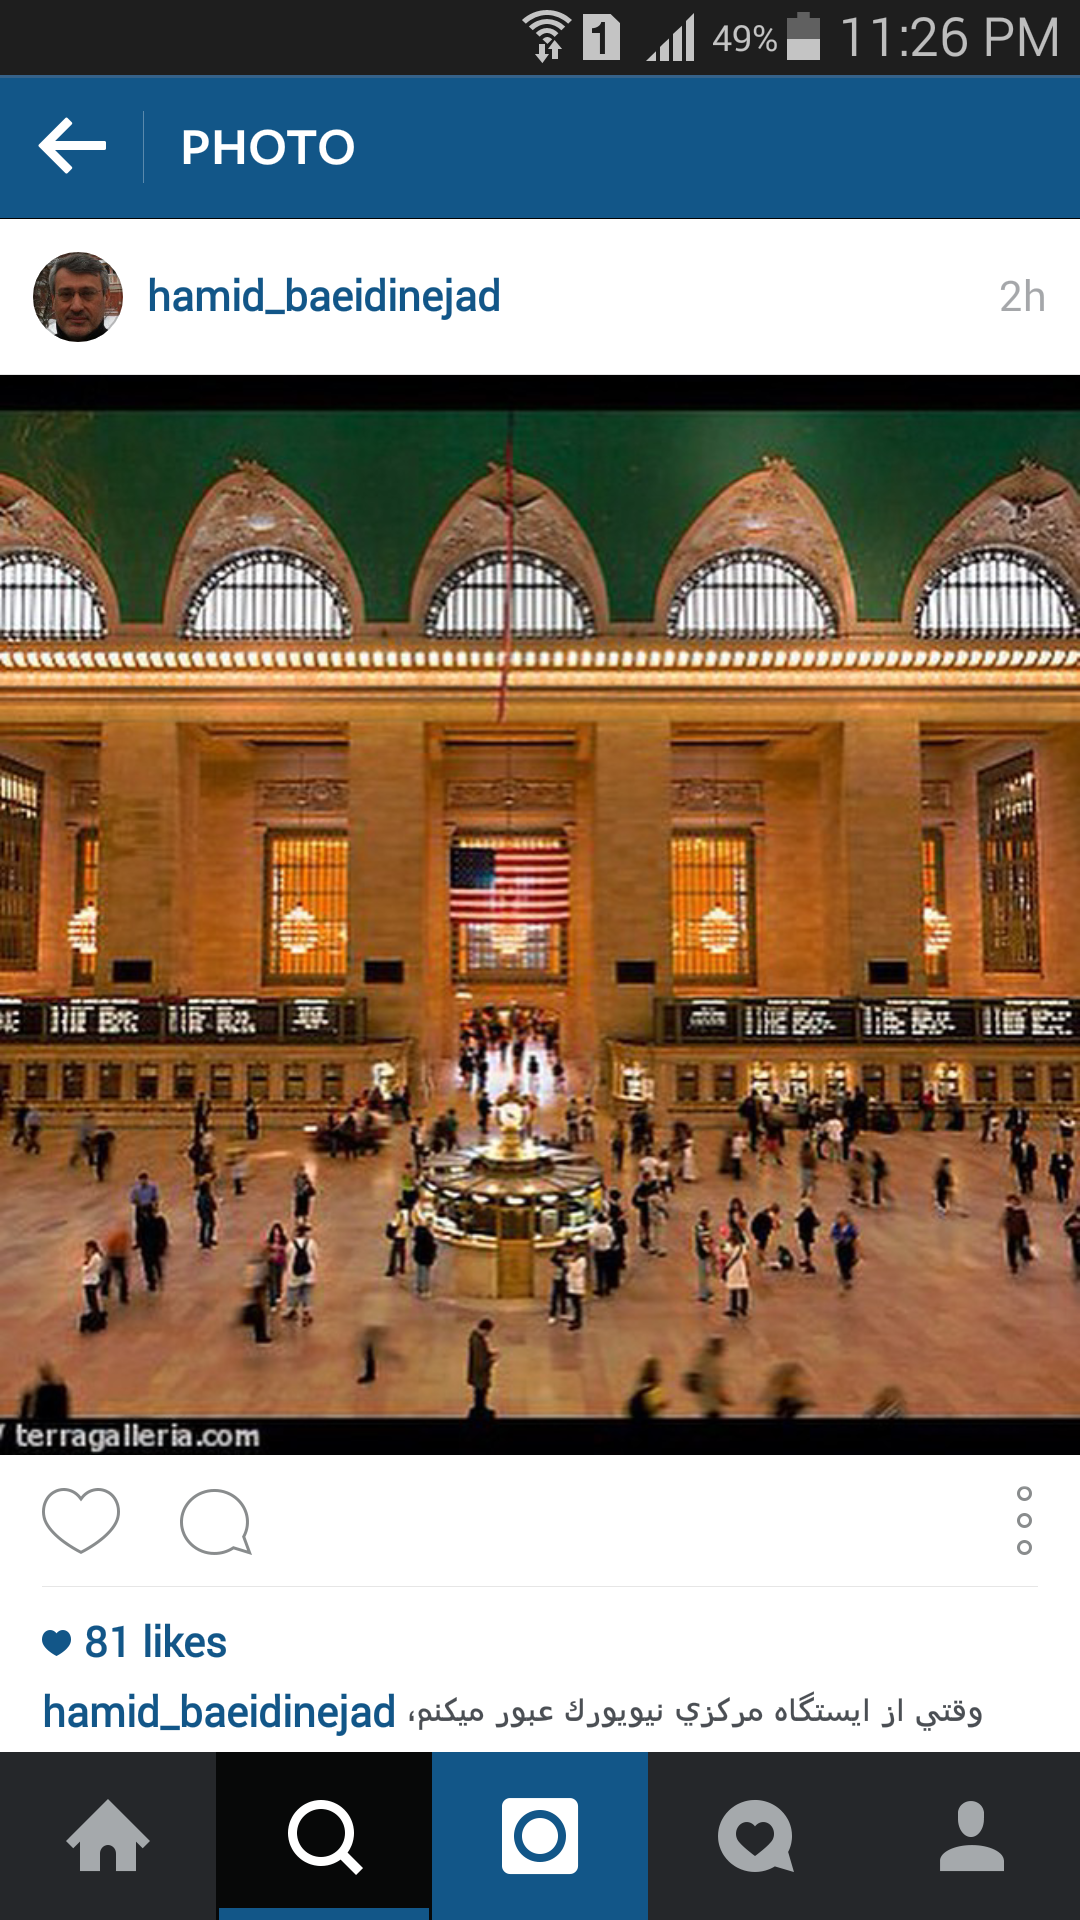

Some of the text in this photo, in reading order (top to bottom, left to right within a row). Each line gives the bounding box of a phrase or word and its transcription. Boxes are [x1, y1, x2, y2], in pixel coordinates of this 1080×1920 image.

[592, 21, 606, 55] 1
[712, 24, 778, 53] 49%
[842, 16, 1058, 58] 11:26 PM
[182, 128, 356, 166] PHOTO
[148, 276, 501, 321] hamid_baeidinejad
[1000, 278, 1046, 312] 2h
[85, 1622, 227, 1659] 81 likes
[43, 1692, 395, 1737] hamid_baeidinejad
[494, 1705, 553, 1729] عبور
[880, 1697, 903, 1729] از
